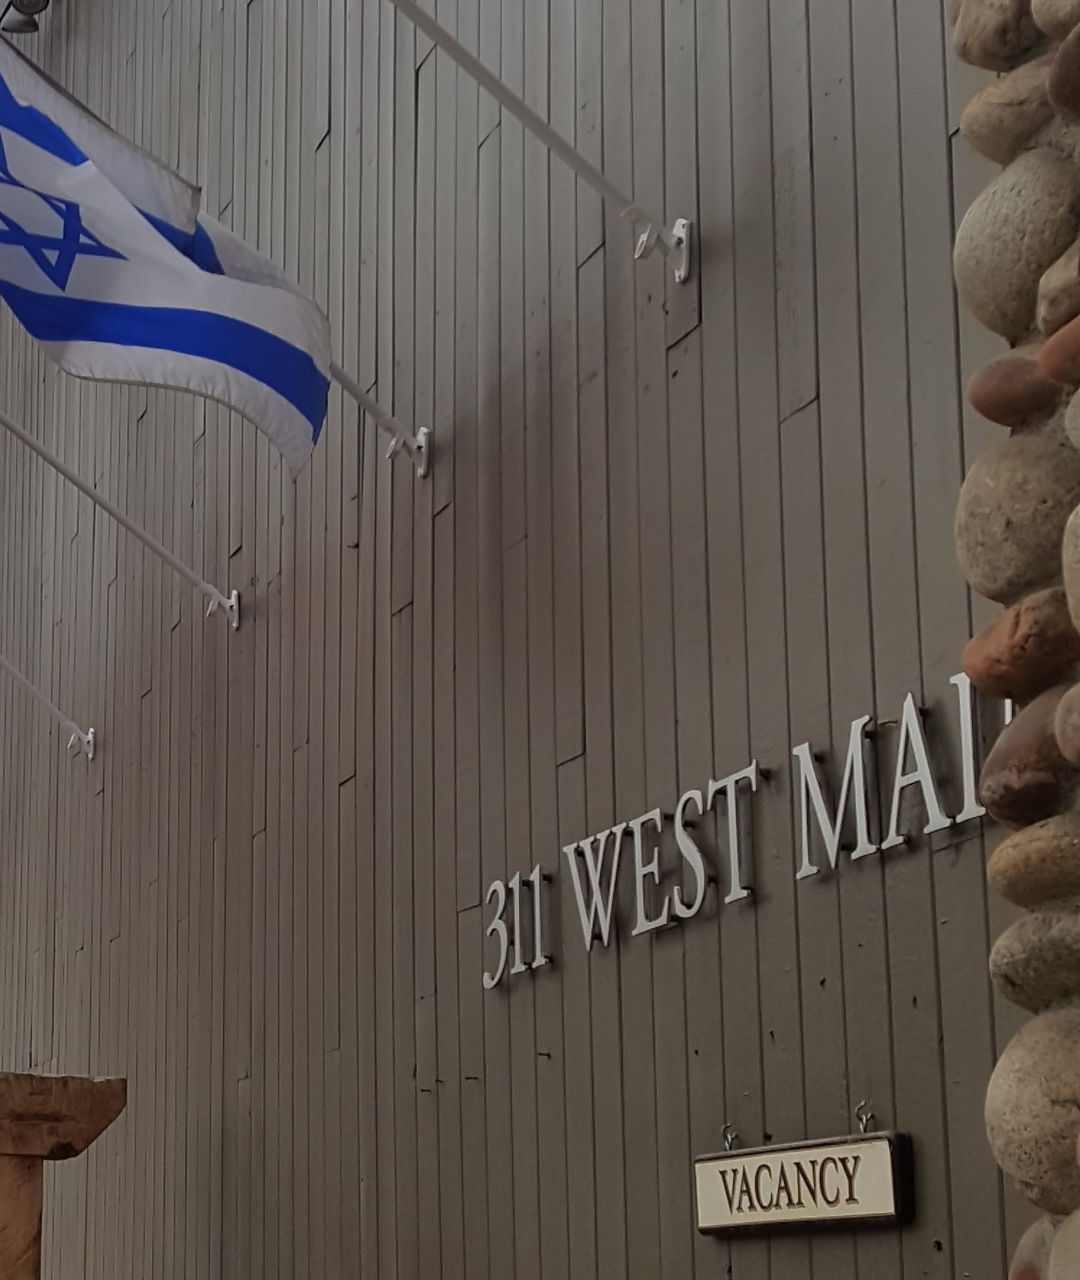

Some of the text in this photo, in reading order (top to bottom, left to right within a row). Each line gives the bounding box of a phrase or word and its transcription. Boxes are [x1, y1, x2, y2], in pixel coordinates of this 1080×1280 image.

[482, 671, 1013, 990] 311 WEST MAI
[719, 1155, 861, 1215] VACANCY
